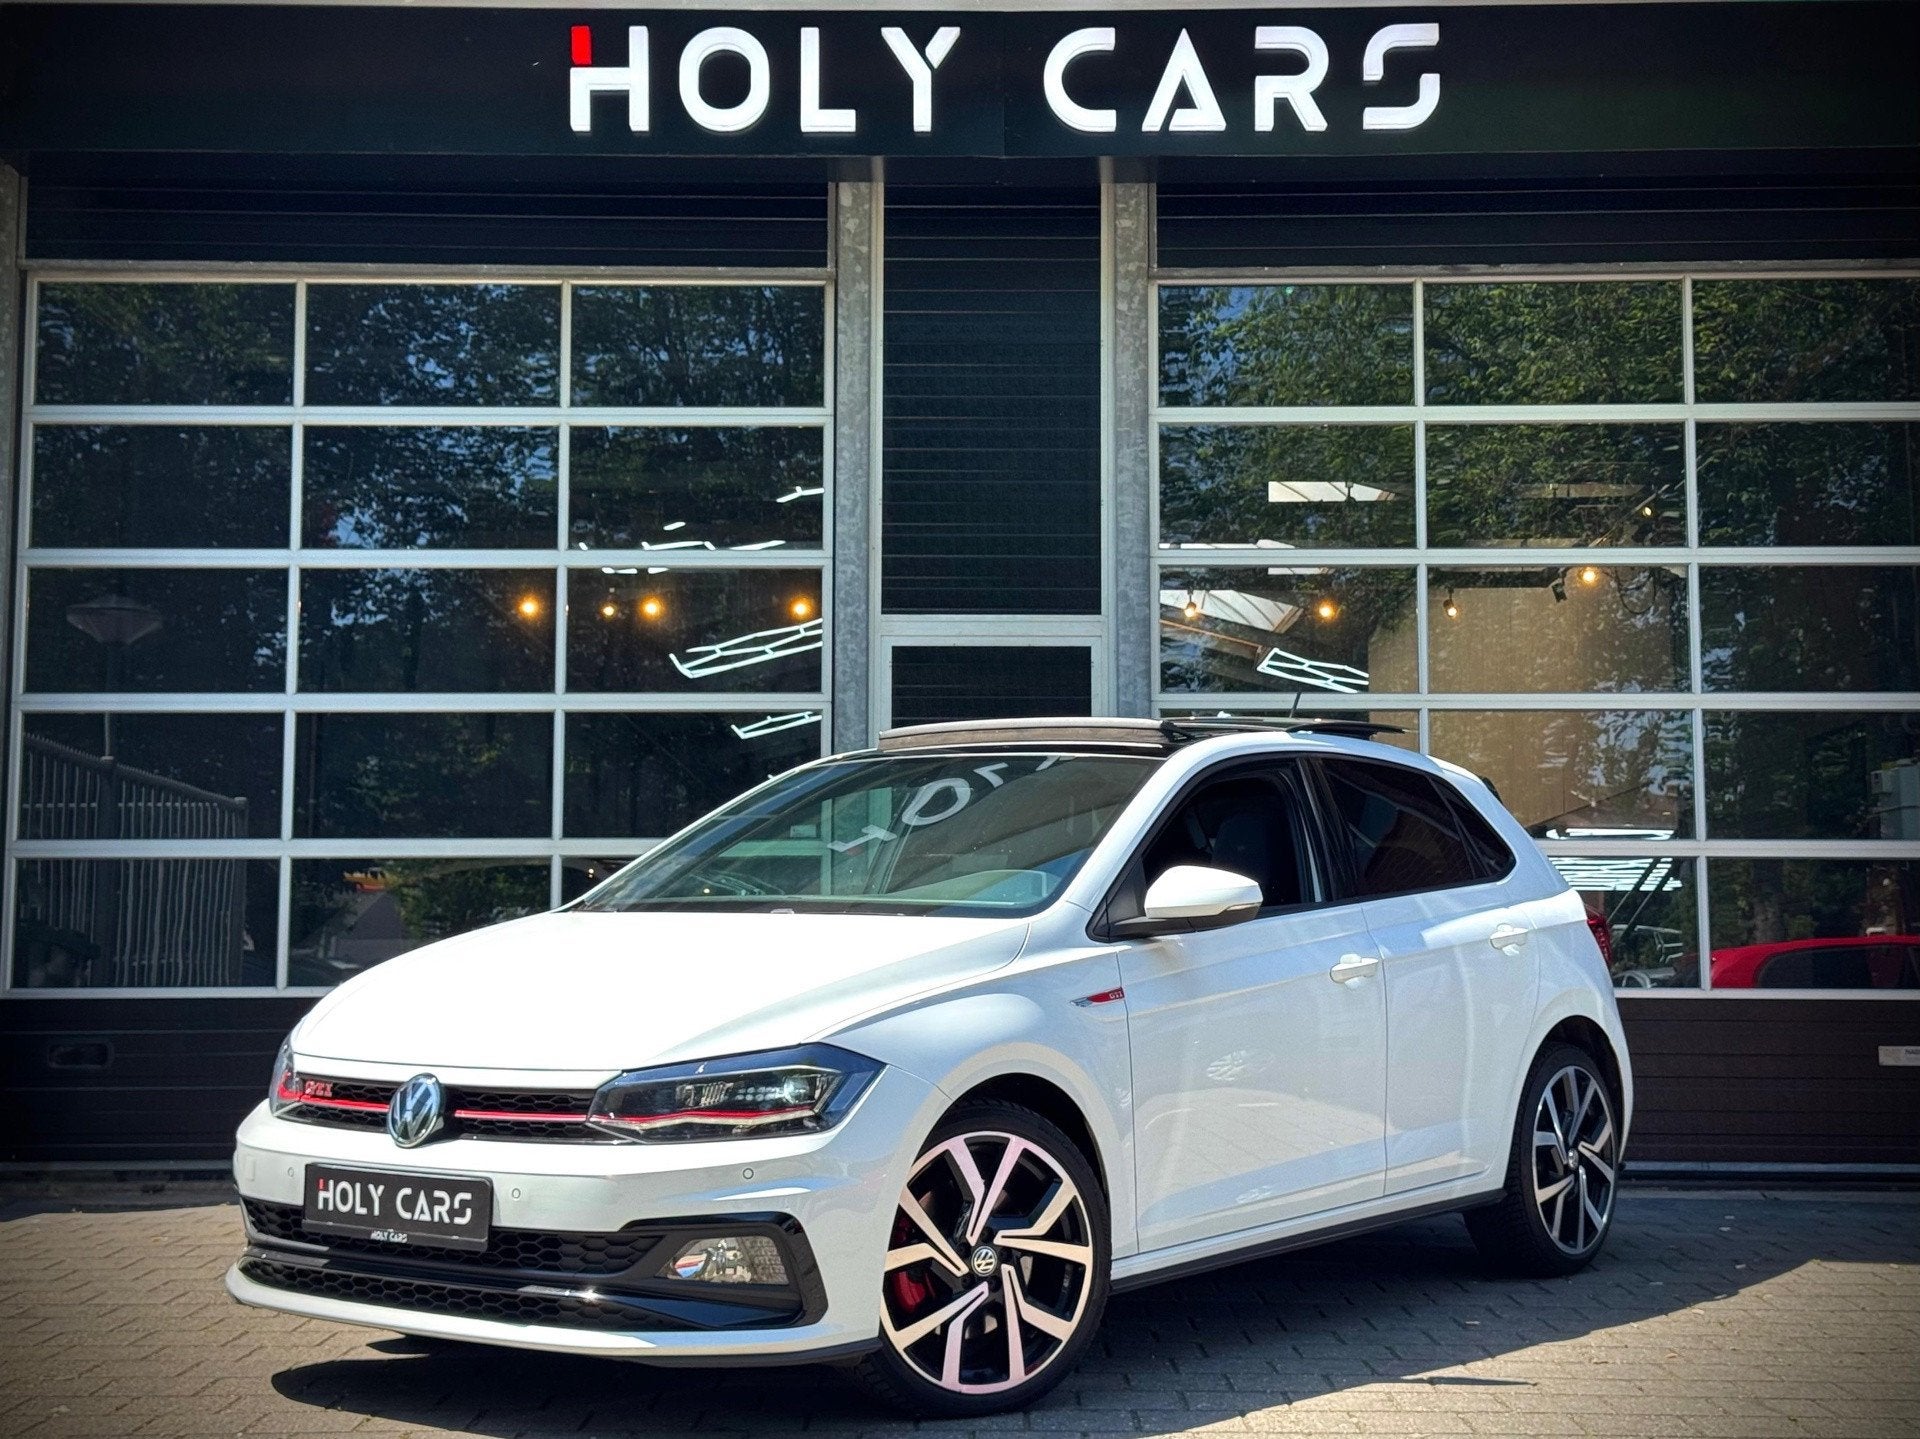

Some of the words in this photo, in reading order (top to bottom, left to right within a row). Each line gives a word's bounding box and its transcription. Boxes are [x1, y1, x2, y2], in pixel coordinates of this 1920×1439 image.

[570, 25, 961, 133] HOLY
[1043, 22, 1441, 133] CARS
[317, 1178, 386, 1217] HOLY
[395, 1187, 473, 1226] CARS
